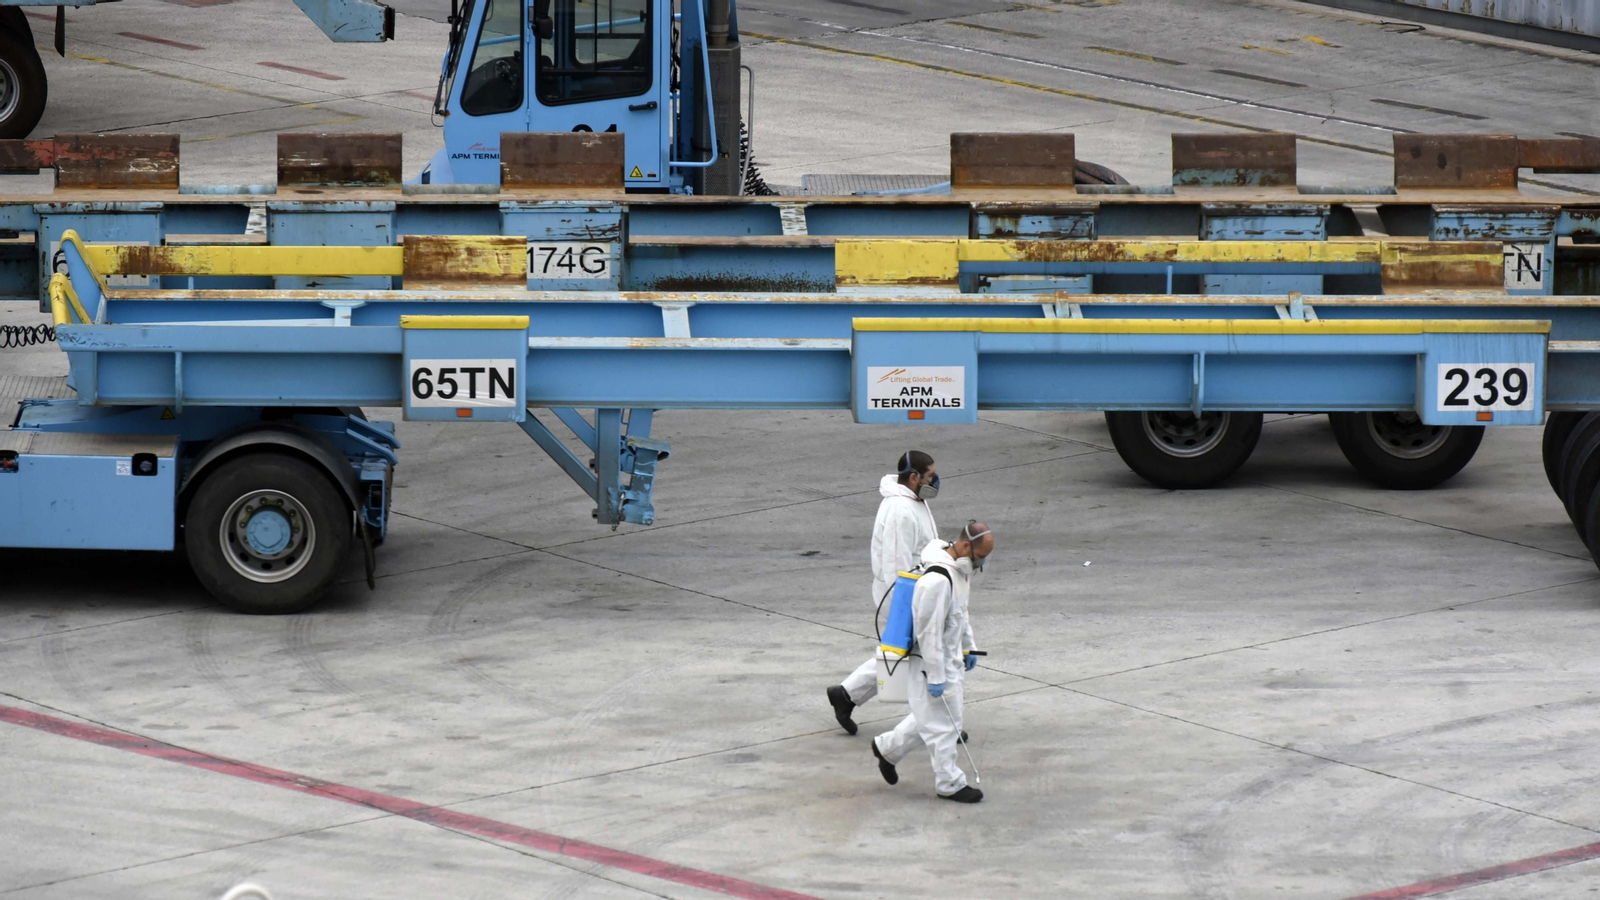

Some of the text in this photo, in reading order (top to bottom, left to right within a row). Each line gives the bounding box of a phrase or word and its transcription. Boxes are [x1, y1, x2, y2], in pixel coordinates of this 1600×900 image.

[527, 246, 606, 274] 174G
[412, 367, 515, 399] 65TN
[890, 376, 911, 384] Lifting
[1443, 367, 1528, 406] 239
[899, 386, 933, 396] APM
[871, 398, 961, 408] TERMINALS
